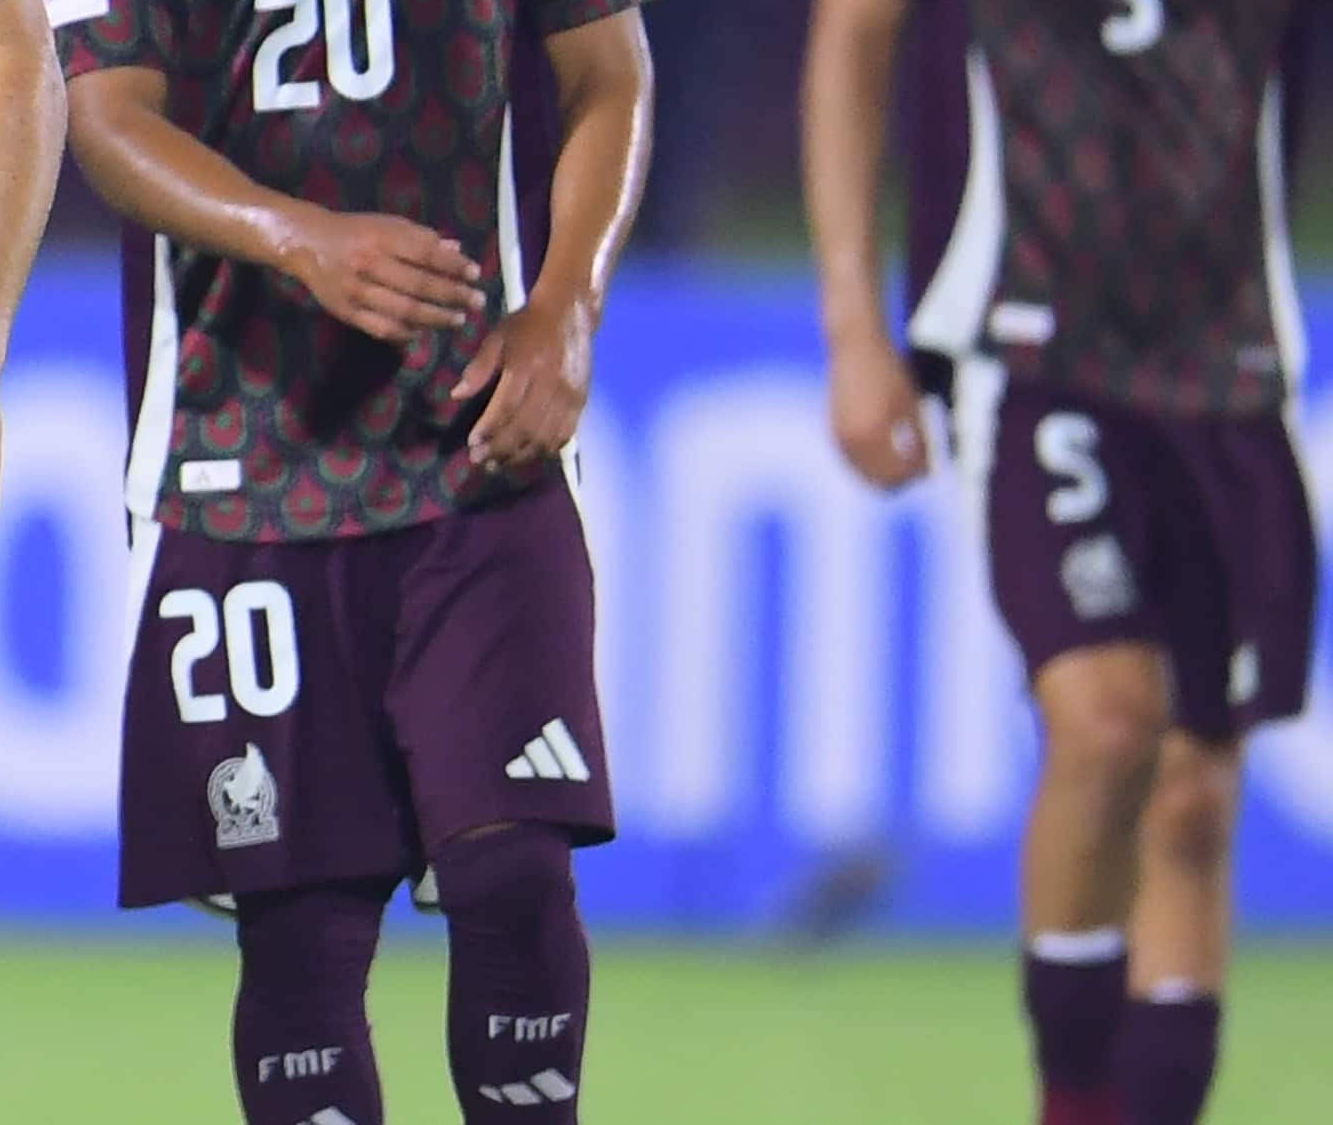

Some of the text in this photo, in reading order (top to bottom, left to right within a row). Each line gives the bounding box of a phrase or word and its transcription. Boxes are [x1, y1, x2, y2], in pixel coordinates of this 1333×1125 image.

[1034, 411, 1109, 525] 5
[159, 580, 300, 724] 20
[257, 1046, 343, 1083] FMF
[488, 1012, 572, 1043] FMF
